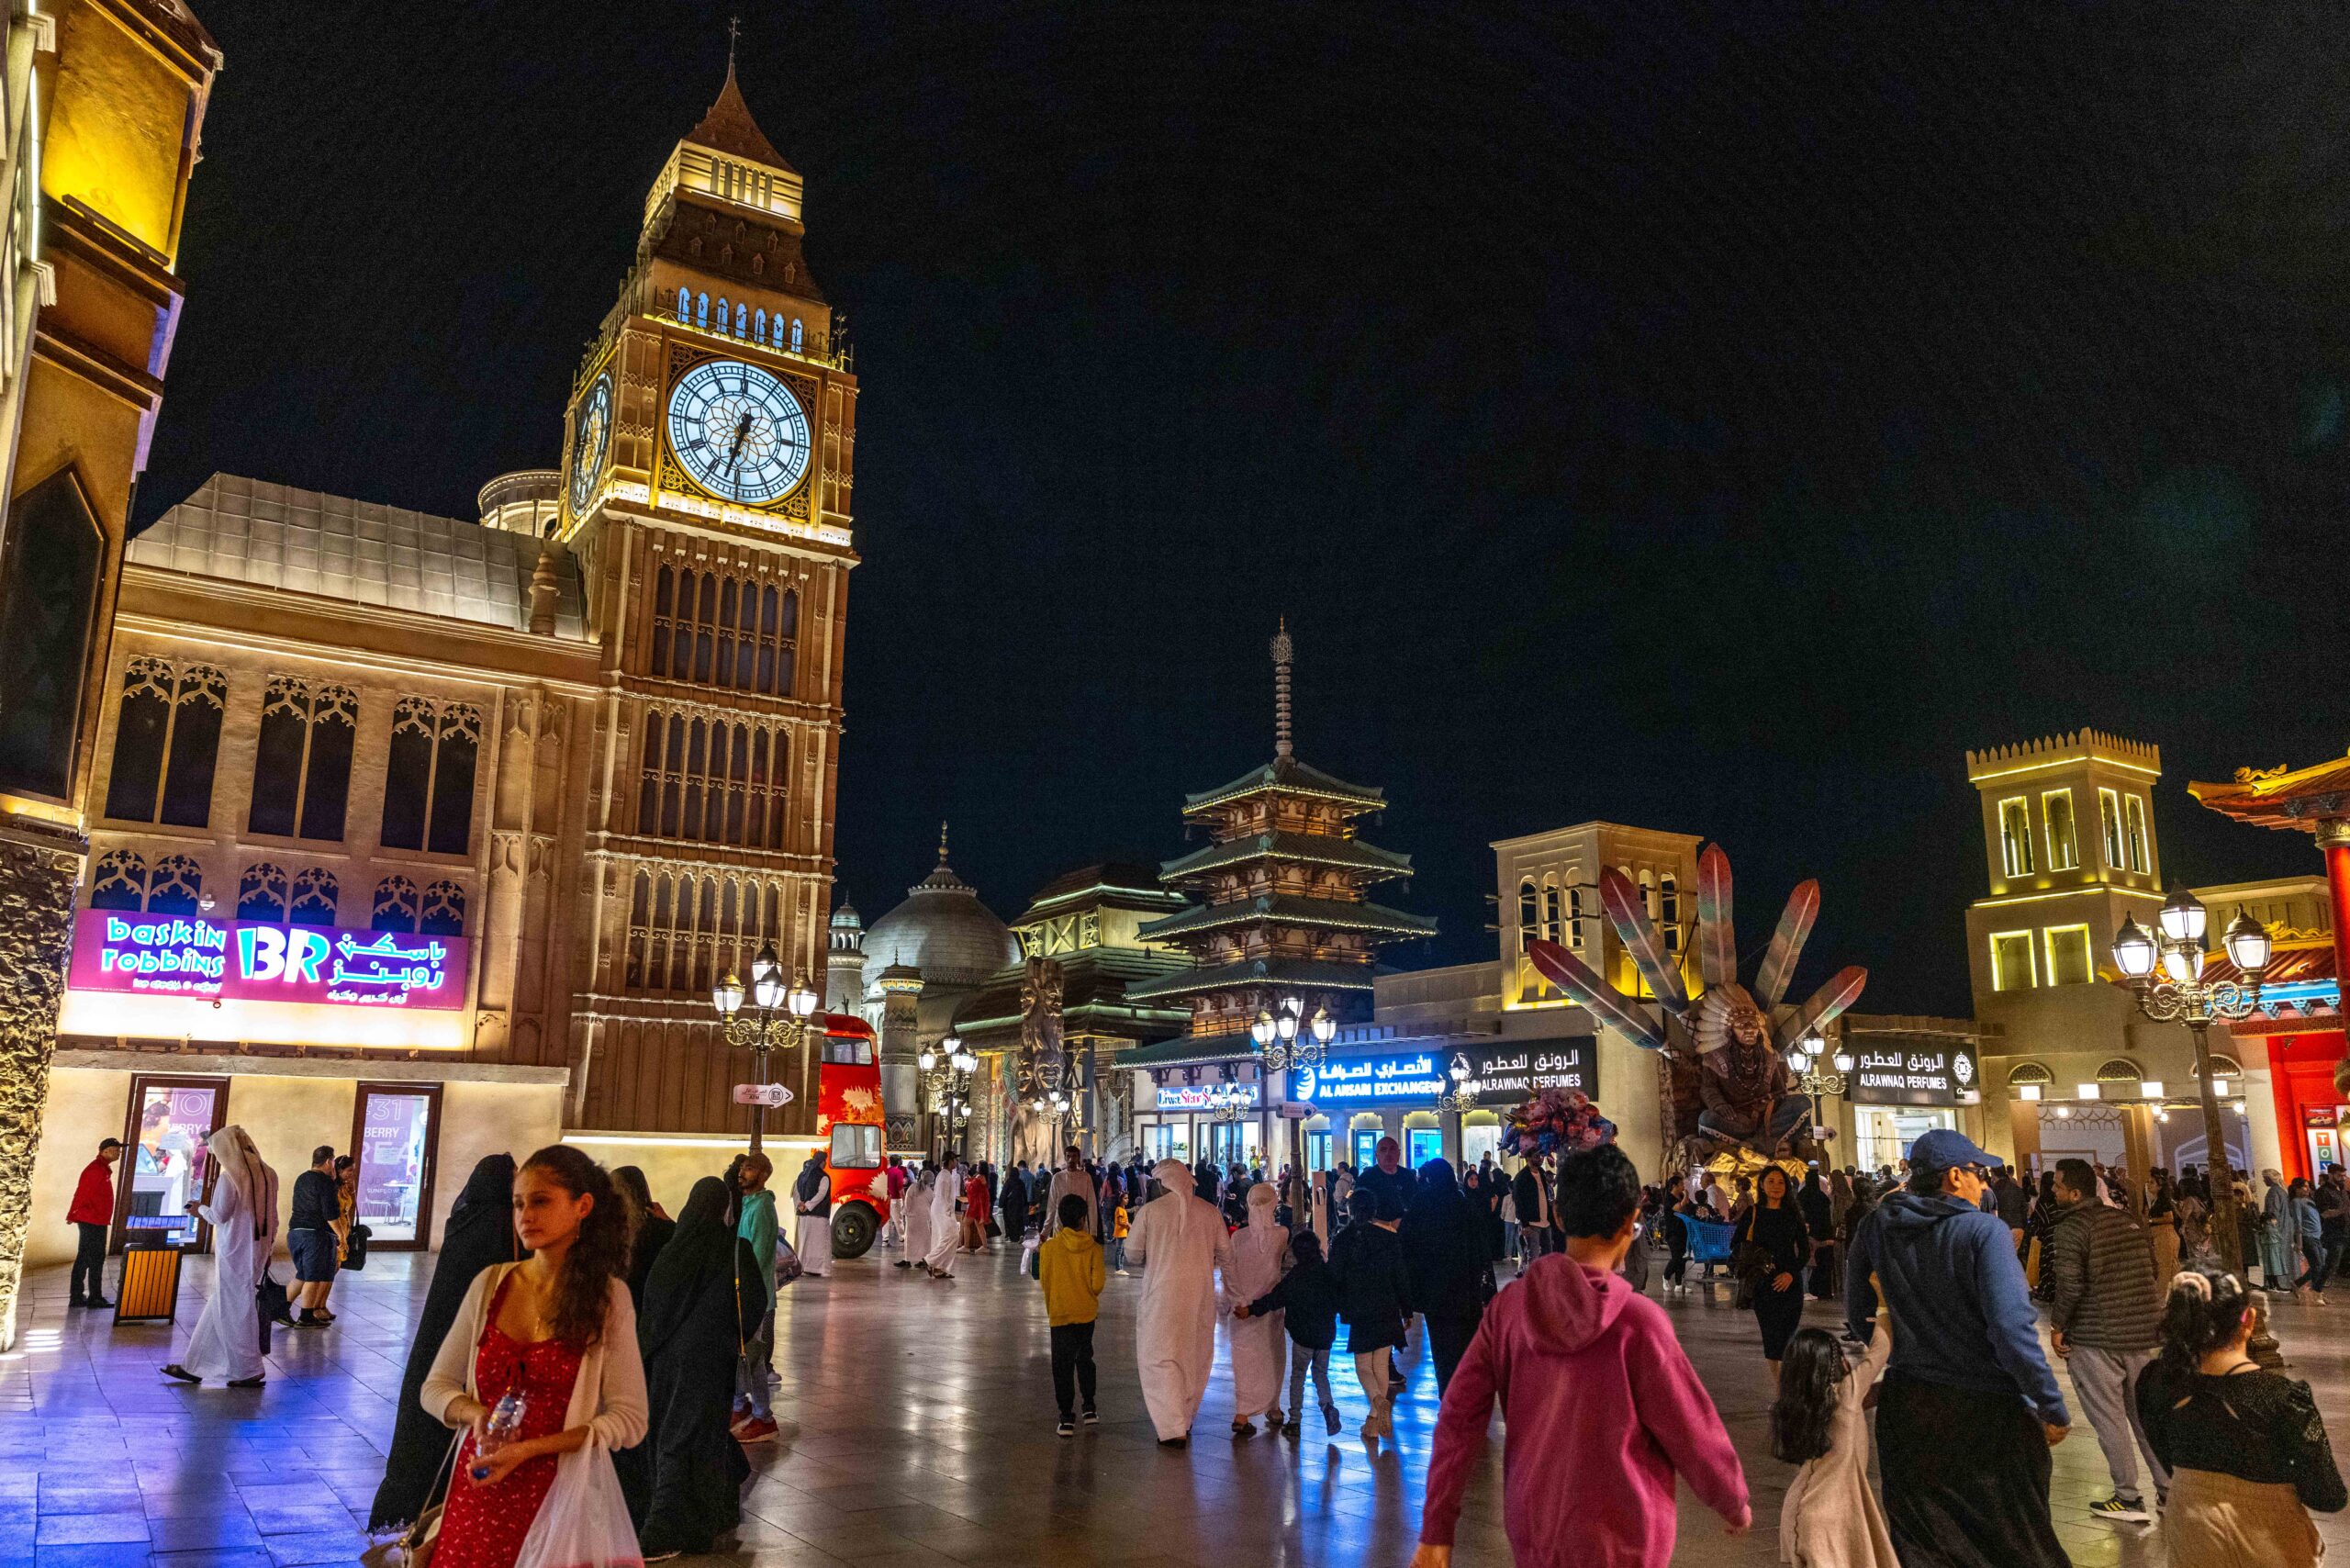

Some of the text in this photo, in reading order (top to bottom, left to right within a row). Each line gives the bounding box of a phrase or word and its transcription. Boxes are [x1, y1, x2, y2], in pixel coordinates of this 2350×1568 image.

[107, 917, 227, 952] baskin
[101, 947, 226, 978] robbins
[237, 926, 330, 983] BR
[328, 959, 444, 991] روبنز
[1482, 1049, 1579, 1074] الرونق للعطور
[1860, 1051, 1943, 1072] الرونق للعطور
[1319, 1085, 1333, 1098] AL
[1374, 1081, 1432, 1096] EXCHANGE
[1860, 1074, 1947, 1090] ALRAWNAQ PERFUMES
